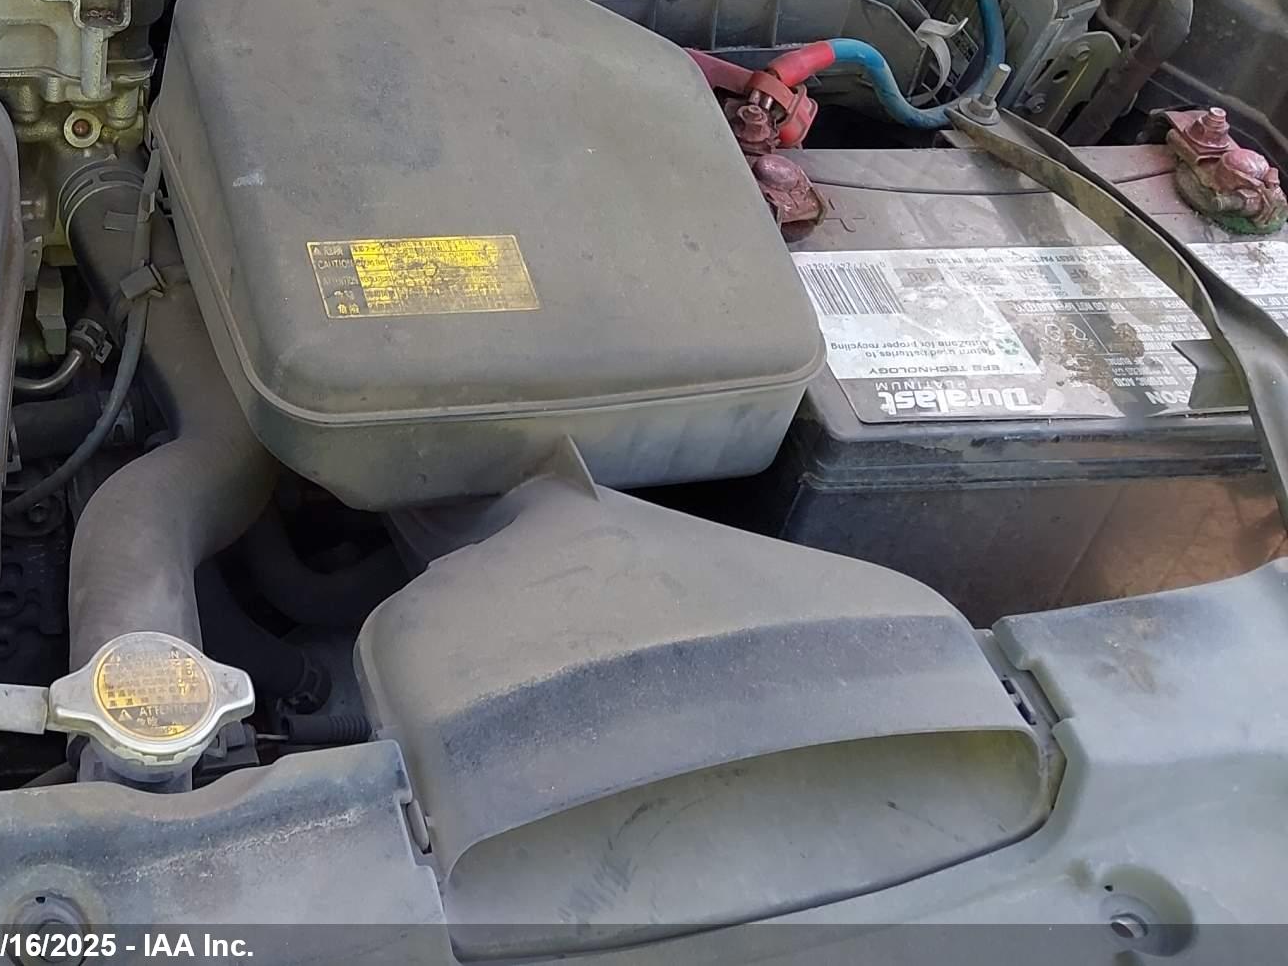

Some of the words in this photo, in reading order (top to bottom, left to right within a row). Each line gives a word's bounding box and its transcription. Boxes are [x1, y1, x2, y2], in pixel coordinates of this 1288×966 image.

[830, 340, 880, 351] recycling
[868, 364, 966, 375] TECHNOLOGY
[874, 379, 966, 390] PLATINUM
[878, 386, 1042, 415] Duralast
[1144, 390, 1188, 404] SON
